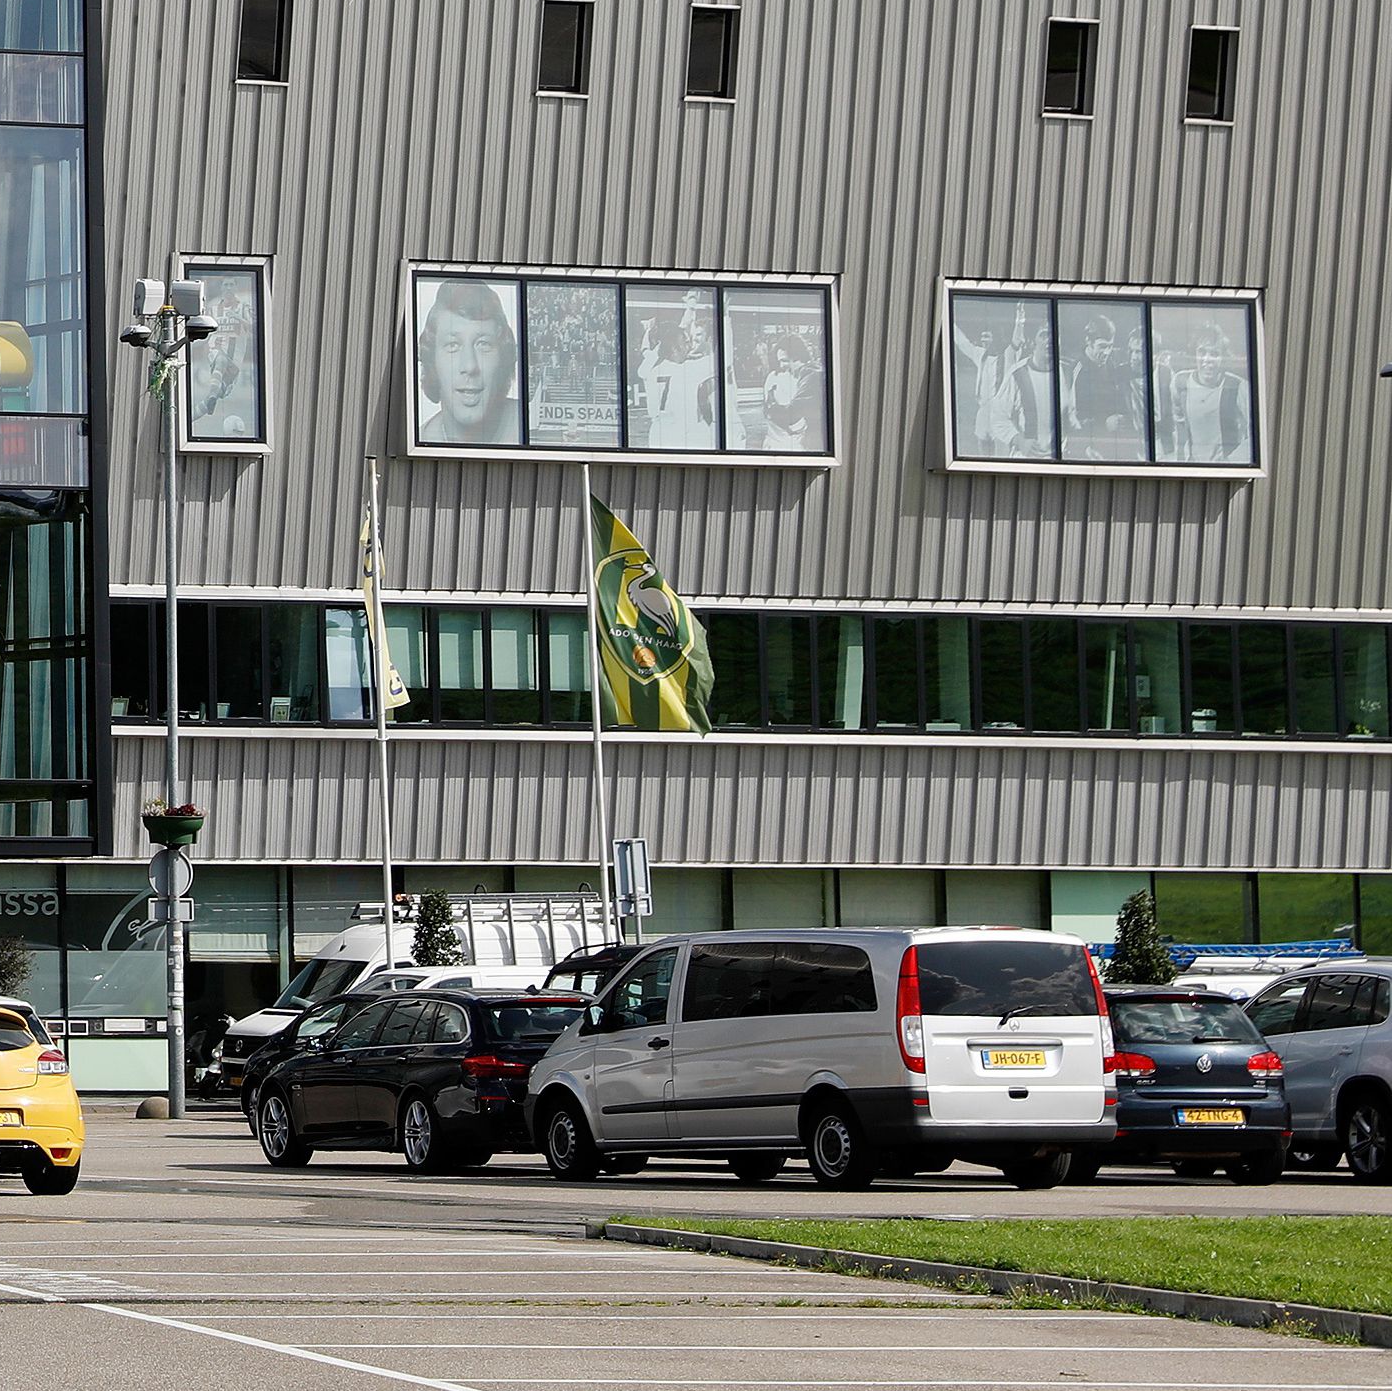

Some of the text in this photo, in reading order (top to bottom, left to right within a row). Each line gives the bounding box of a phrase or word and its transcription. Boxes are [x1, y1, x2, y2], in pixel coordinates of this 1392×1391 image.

[656, 376, 672, 411] 7
[609, 628, 682, 650] ADO DEN HAAG
[993, 1053, 1041, 1064] JH-067-F
[1186, 1109, 1241, 1121] 42-TNG-4
